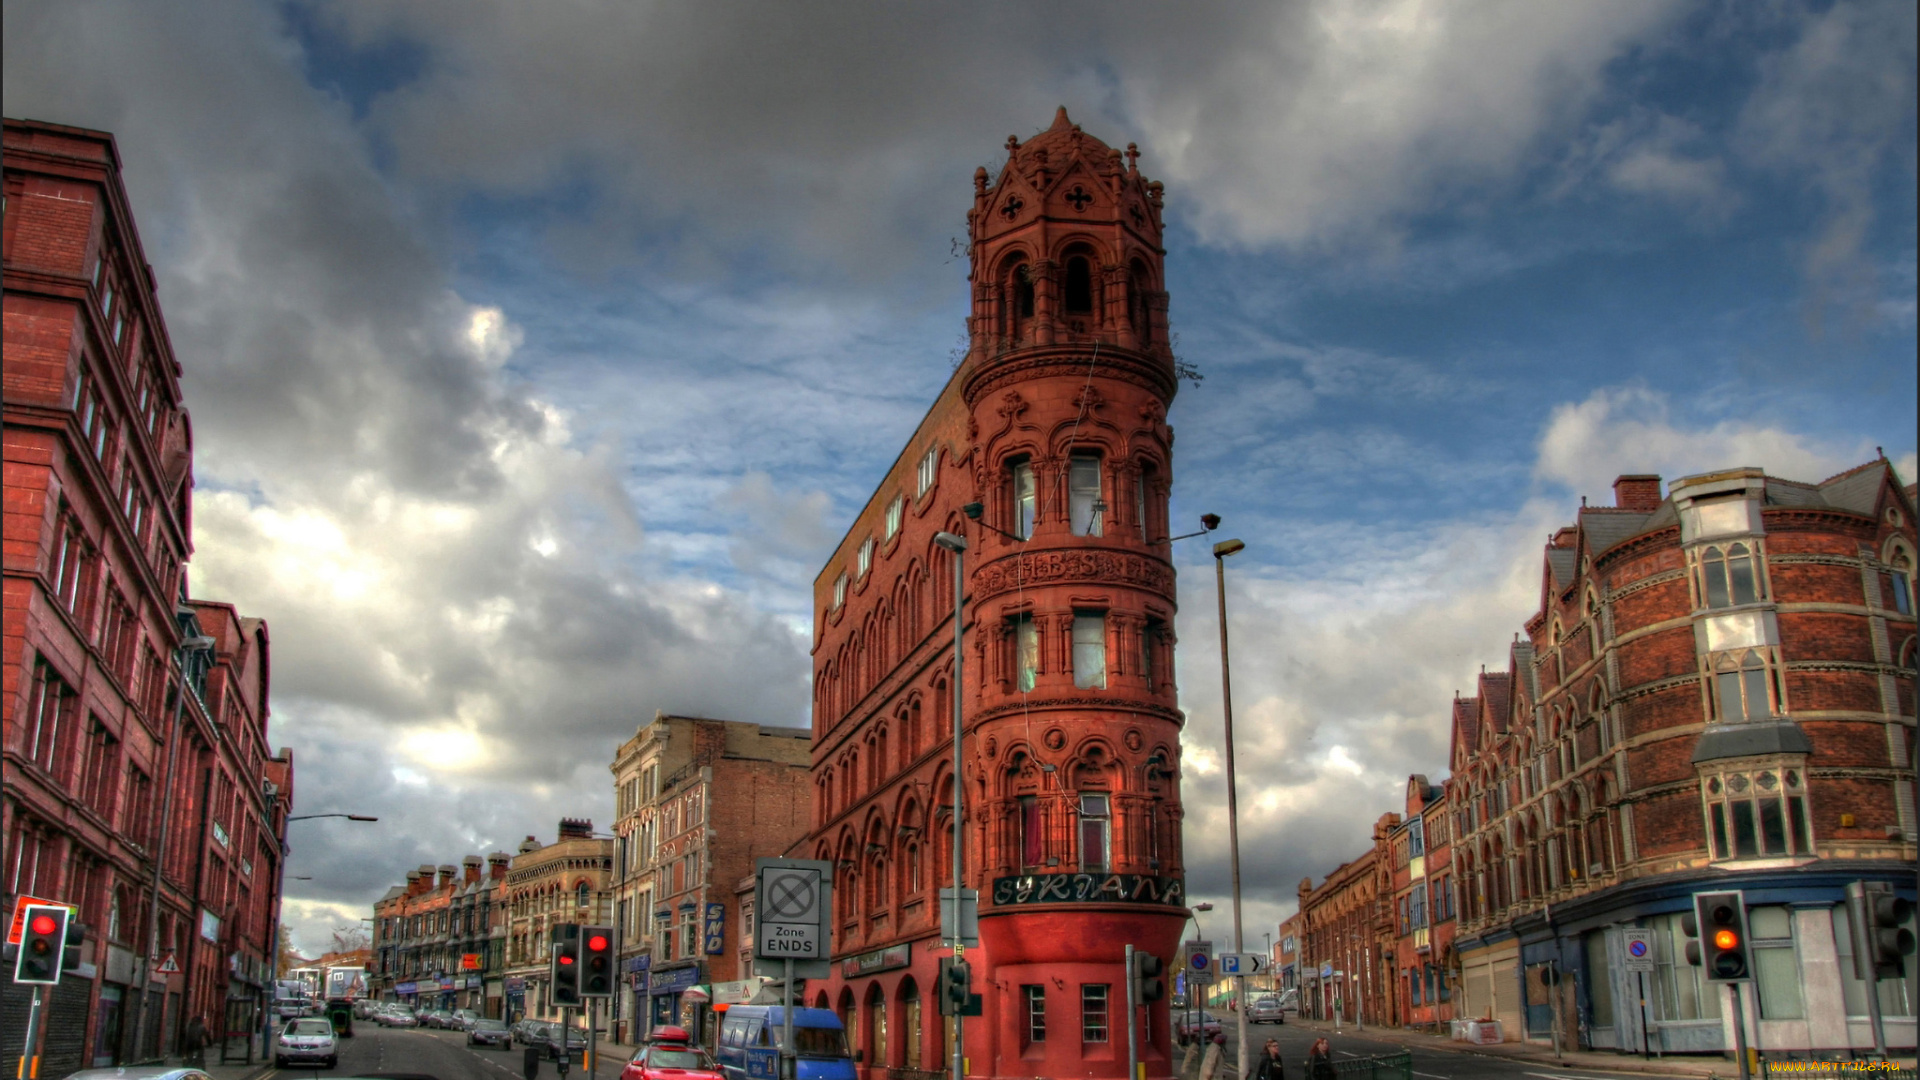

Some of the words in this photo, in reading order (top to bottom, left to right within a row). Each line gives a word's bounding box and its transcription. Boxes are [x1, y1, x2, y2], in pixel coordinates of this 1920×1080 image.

[706, 904, 724, 953] SND
[775, 926, 805, 937] Zone
[767, 938, 813, 952] ENDS
